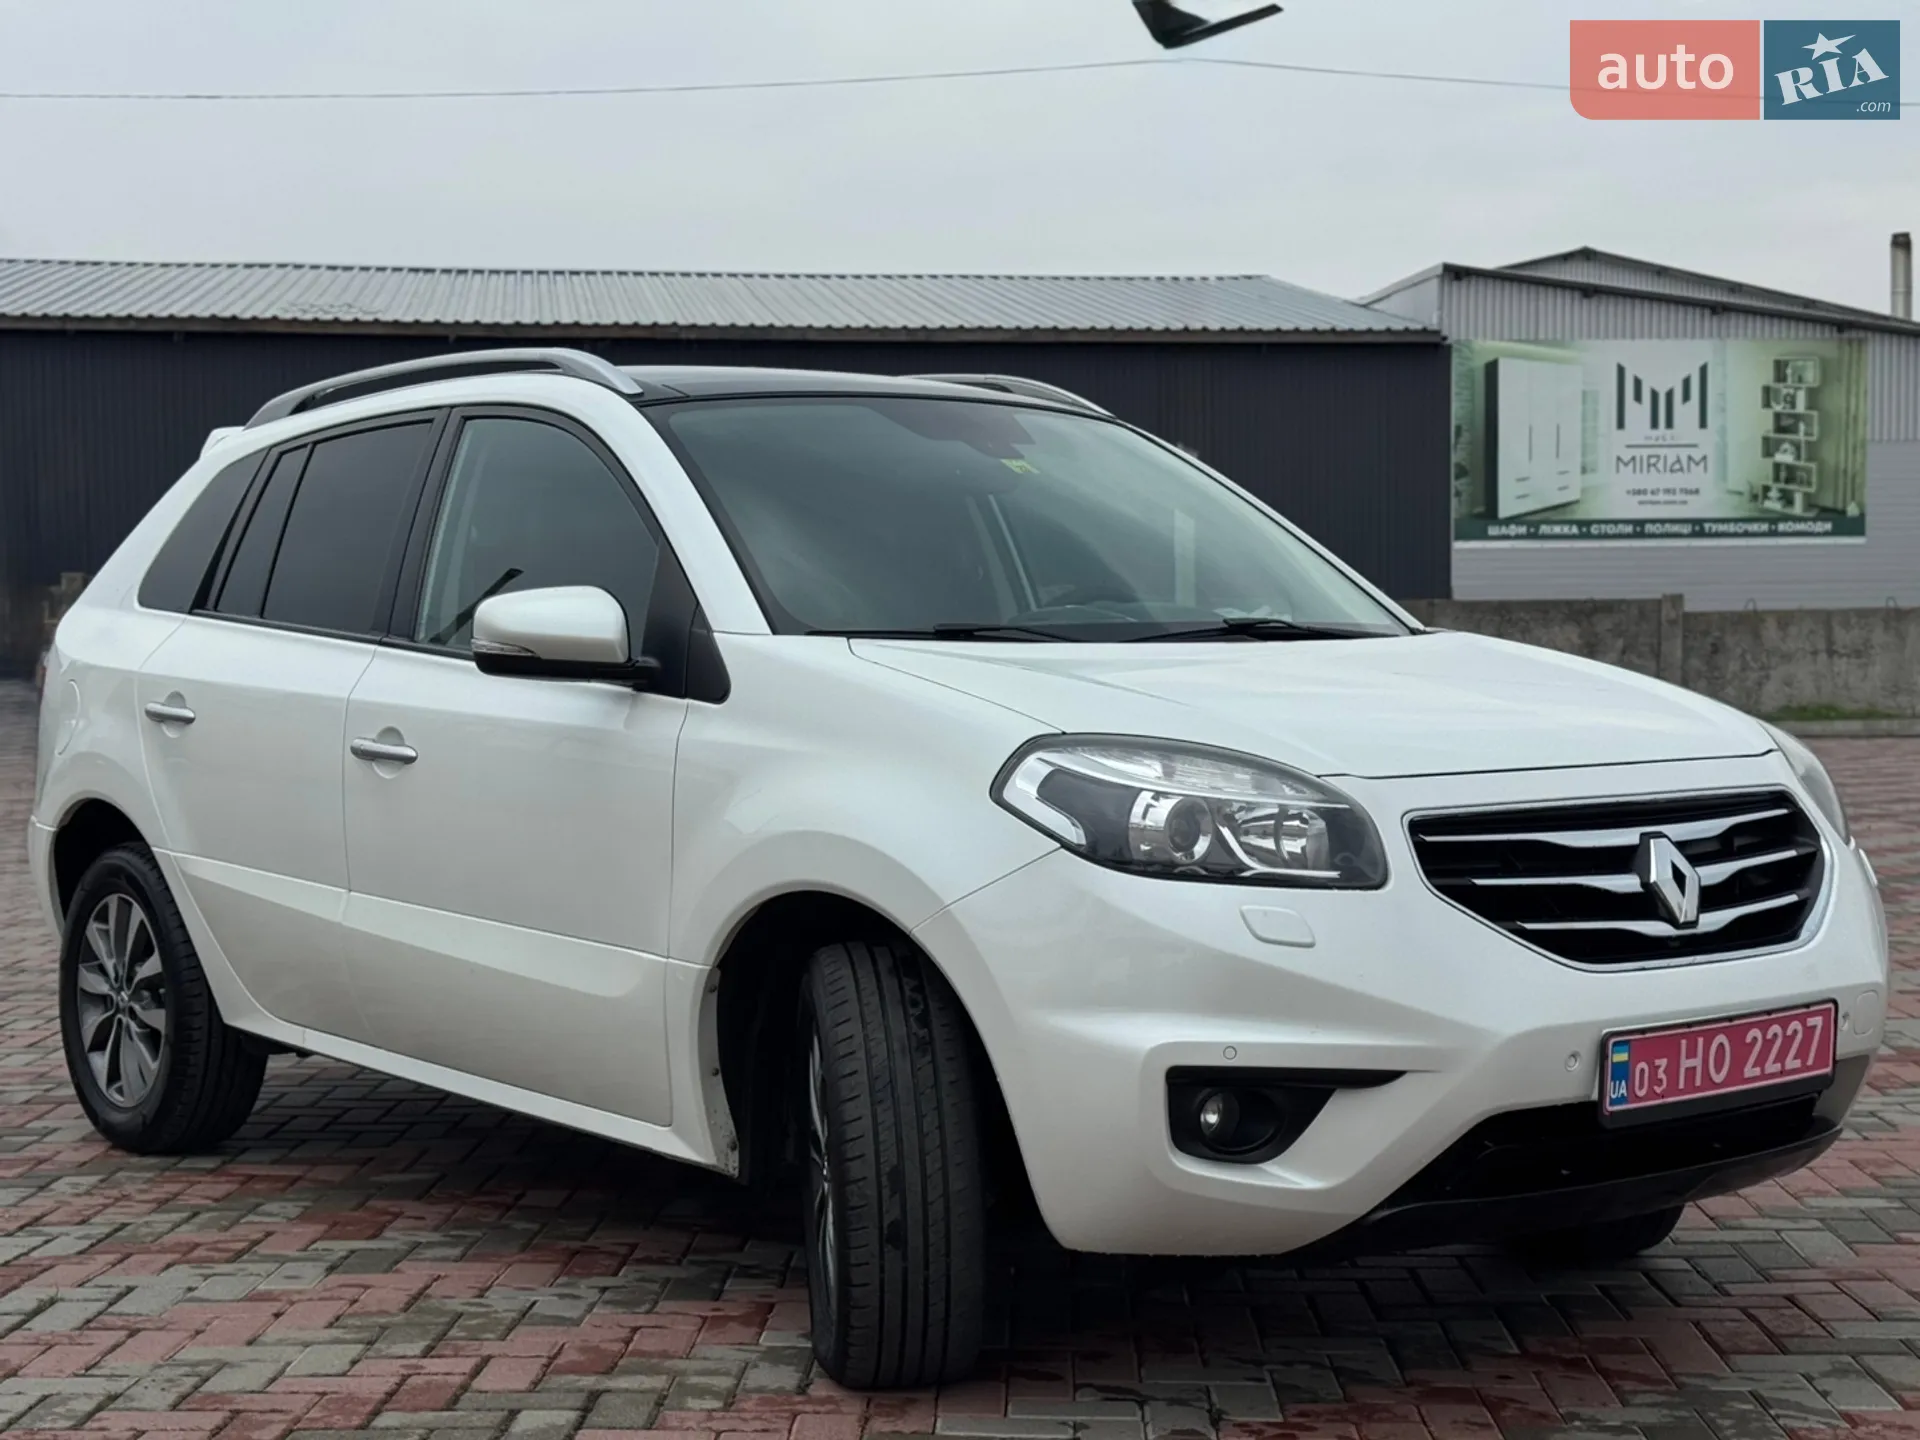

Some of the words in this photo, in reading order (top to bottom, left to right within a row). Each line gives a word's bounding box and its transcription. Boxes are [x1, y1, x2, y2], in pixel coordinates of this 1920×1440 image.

[1615, 453, 1708, 474] MIRIAM
[1590, 523, 1633, 535] СТОЛИ
[1610, 1080, 1628, 1099] UA
[1634, 1057, 1669, 1098] 03
[1743, 1016, 1823, 1079] 2227
